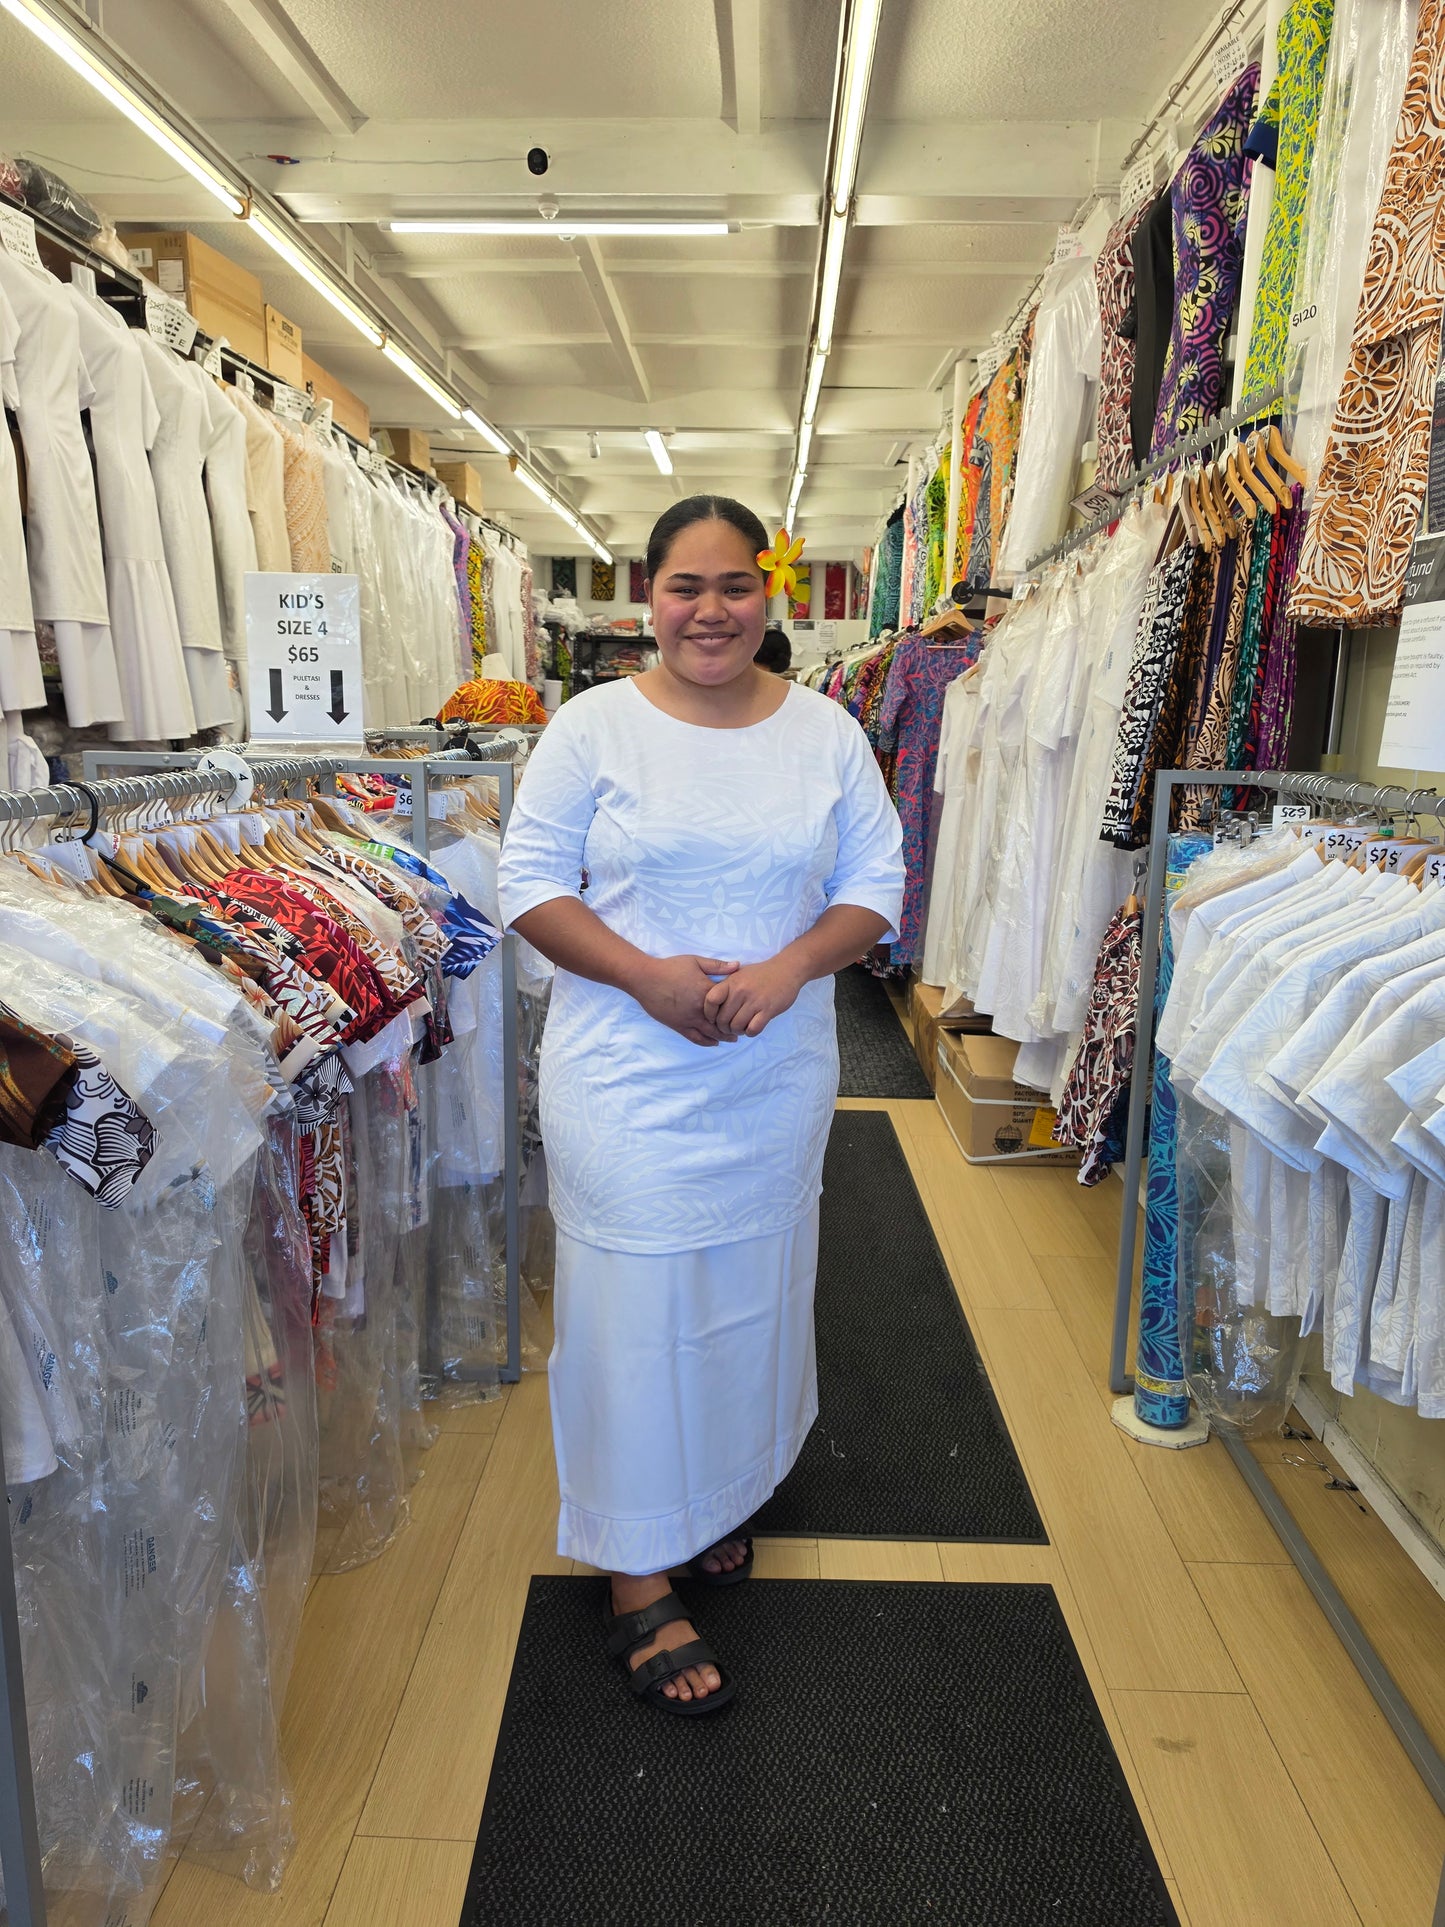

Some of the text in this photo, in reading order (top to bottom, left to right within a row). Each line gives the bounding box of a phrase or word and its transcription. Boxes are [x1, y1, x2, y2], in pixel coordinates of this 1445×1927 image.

[1292, 304, 1317, 327] $120
[1083, 494, 1111, 516] $99
[1409, 558, 1435, 578] fund
[279, 593, 325, 610] KID'S
[277, 620, 329, 636] SIZE 4
[288, 644, 320, 664] $65
[207, 759, 216, 770] 4
[238, 773, 249, 781] 4
[216, 794, 226, 804] 4
[398, 792, 413, 806] $6
[1281, 806, 1307, 818] $25
[1327, 833, 1346, 849] $2
[146, 1536, 157, 1574] DANGER
